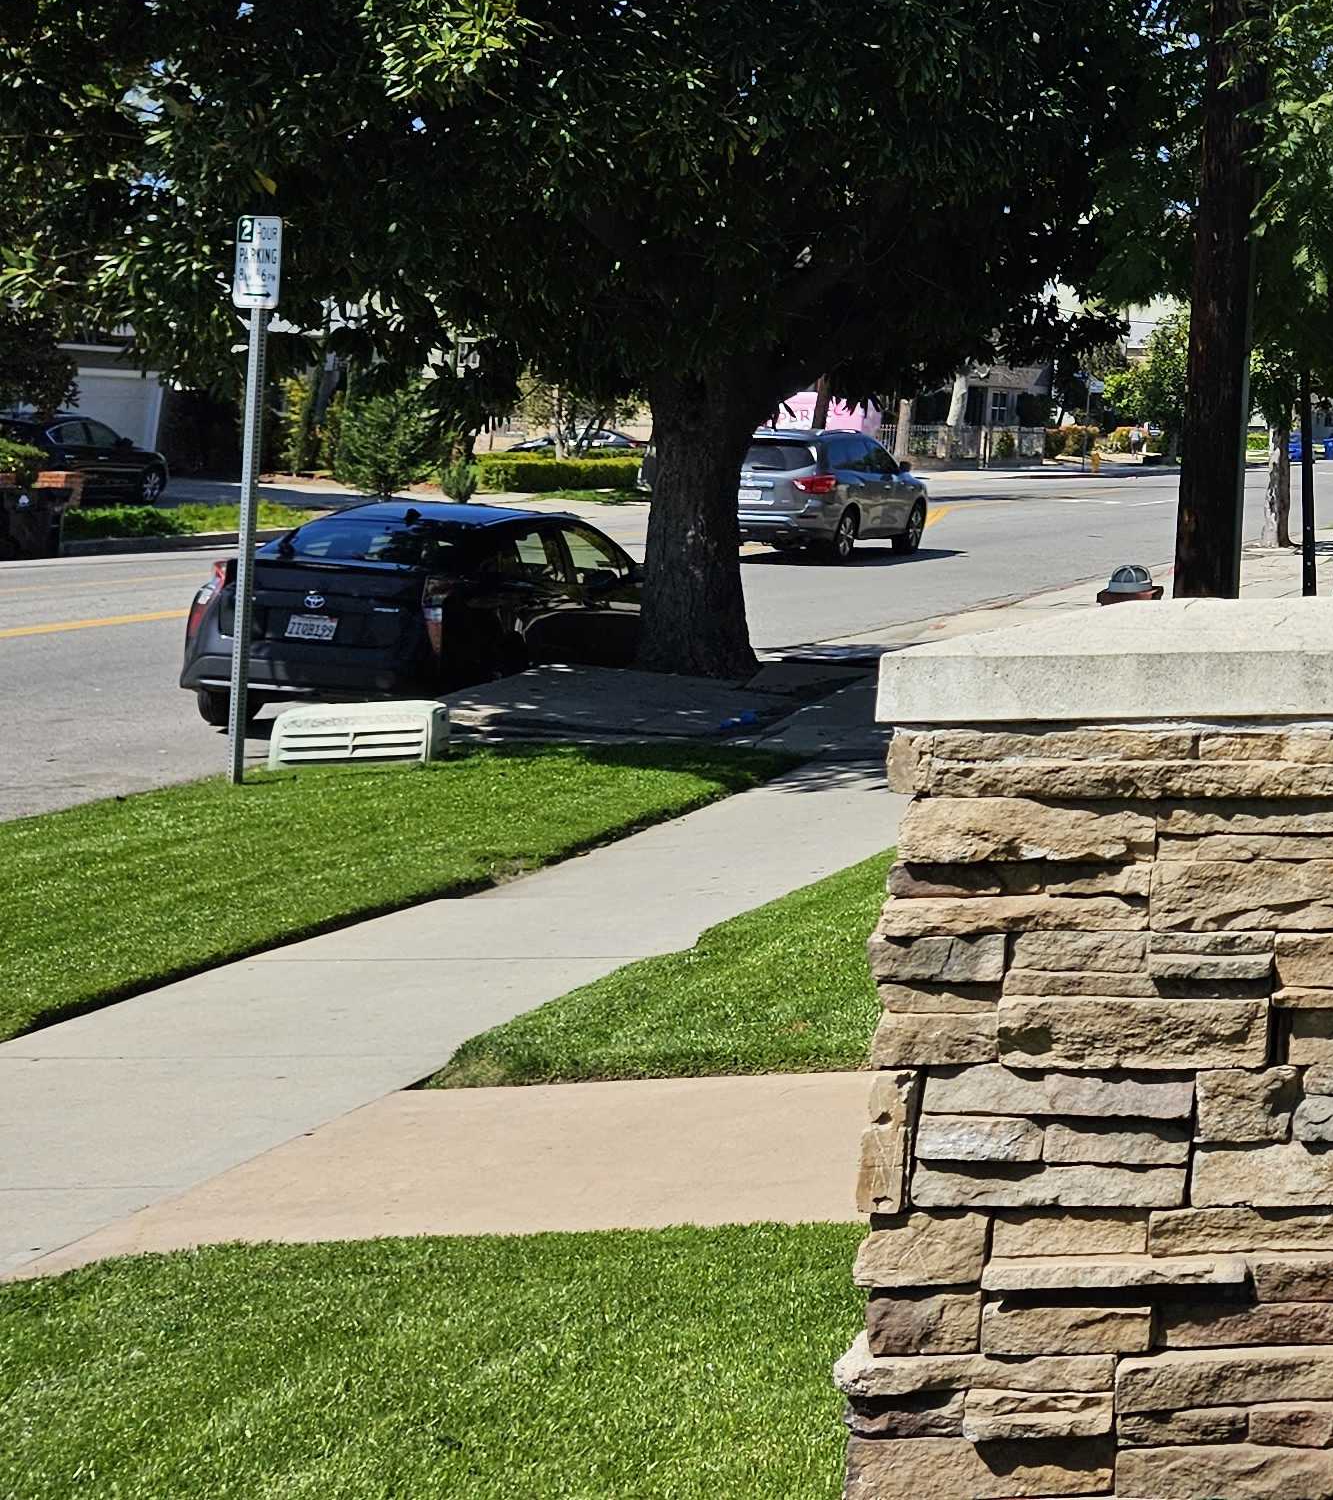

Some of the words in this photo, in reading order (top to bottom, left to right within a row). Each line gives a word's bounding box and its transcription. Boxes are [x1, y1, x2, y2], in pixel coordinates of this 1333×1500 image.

[241, 219, 252, 241] 2
[256, 226, 278, 241] OUR
[239, 246, 277, 265] PARKING
